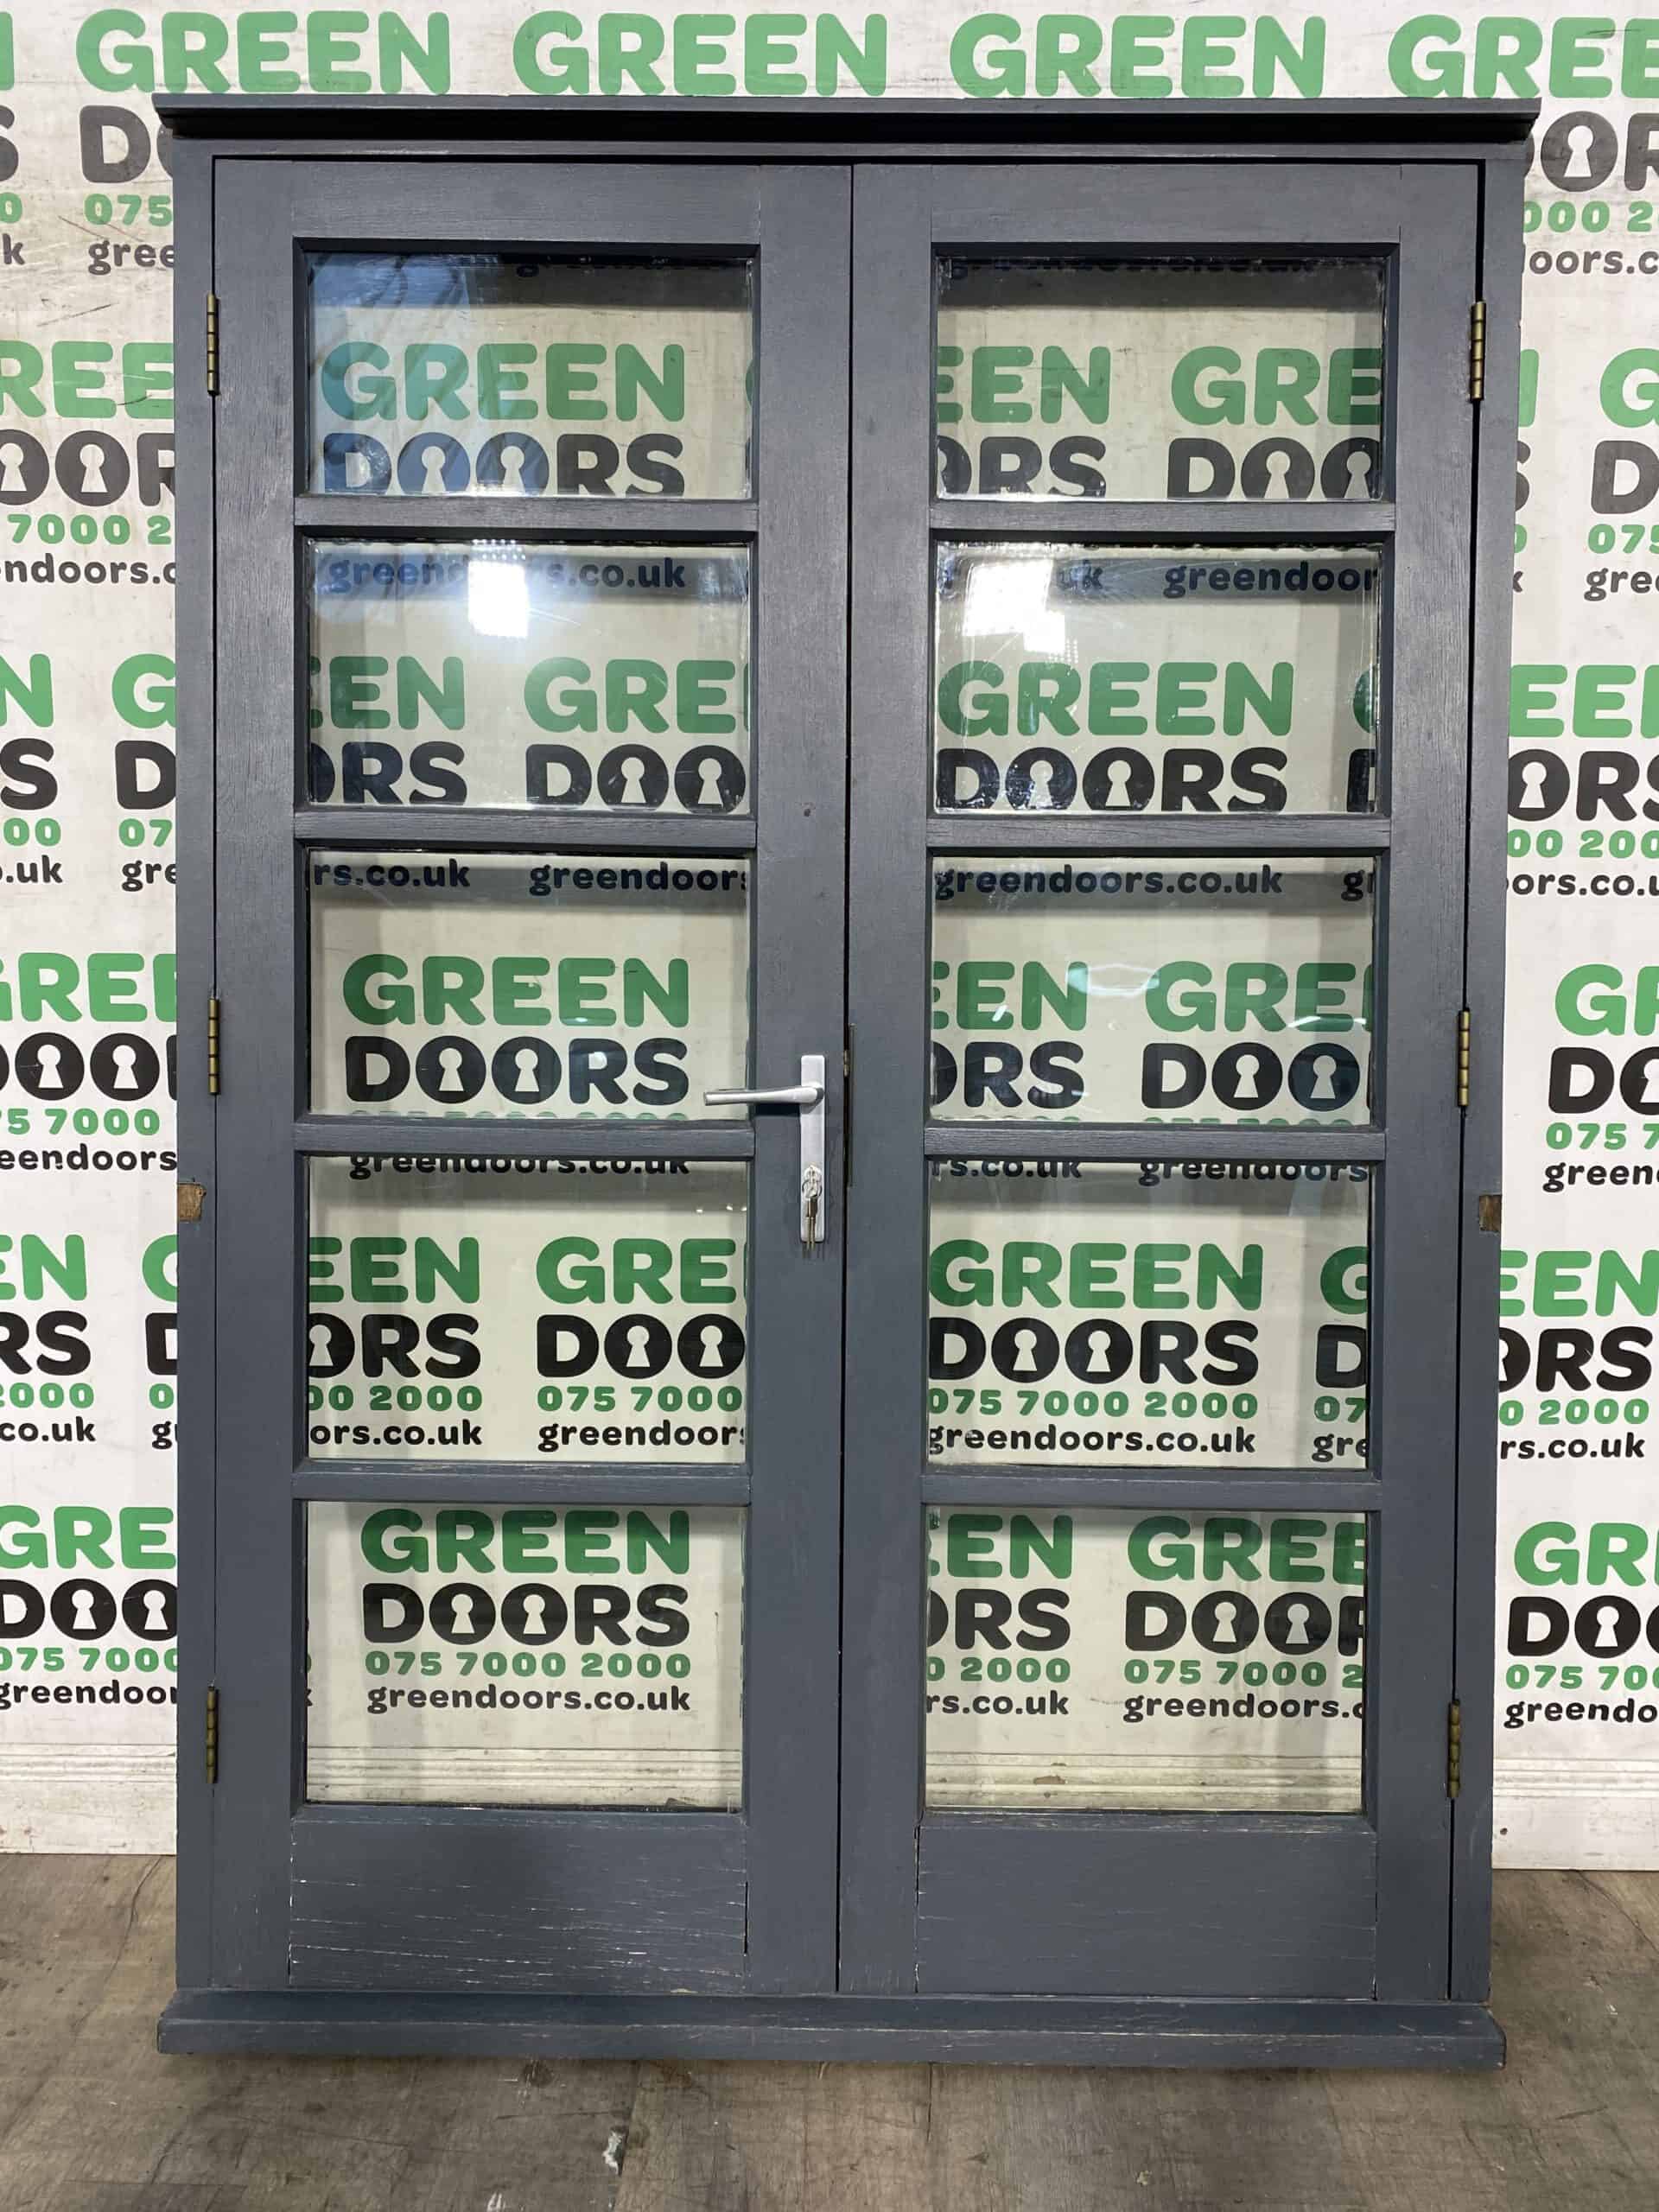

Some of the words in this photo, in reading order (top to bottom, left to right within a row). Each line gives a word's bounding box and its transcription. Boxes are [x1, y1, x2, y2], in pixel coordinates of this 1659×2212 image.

[76, 10, 450, 95] GREEN
[514, 11, 887, 97] GREEN
[950, 14, 1325, 99] GREEN
[84, 194, 173, 226] 075
[322, 341, 684, 423] GREEN
[323, 433, 685, 497] DOORS
[8, 514, 130, 544] 7000
[0, 553, 175, 584] ndoors.c
[1584, 568, 1659, 601] gre
[311, 656, 465, 729] EN
[524, 658, 749, 734] GRE
[938, 663, 1294, 737] GREEN
[936, 747, 1287, 810] DOORS
[934, 865, 1282, 899] greendoors.co.uk
[344, 954, 689, 1027] GREEN
[933, 962, 1087, 1031] EN
[1146, 961, 1371, 1032] GRE
[345, 1036, 689, 1105] DOORS
[1141, 1042, 1370, 1111] DOO
[45, 1108, 160, 1135] 7000
[1546, 1122, 1625, 1150] 075
[1543, 1162, 1659, 1192] green
[537, 1236, 747, 1304] GRE
[930, 1240, 1263, 1309] GREEN
[537, 1314, 746, 1379] DOO
[930, 1317, 1258, 1386] DOORS
[0, 1382, 94, 1408] 000
[372, 1385, 482, 1410] 2000
[537, 1385, 615, 1411] 075
[631, 1385, 741, 1411] 7000
[930, 1388, 1001, 1414] 075
[1018, 1391, 1128, 1416] 7000
[1145, 1391, 1257, 1419] 2000
[1539, 1398, 1649, 1424] 2000
[931, 1424, 1255, 1454] greendoors.co.uk
[362, 1510, 690, 1574] GREEN
[363, 1583, 690, 1647] DOORS
[365, 1651, 441, 1678] 075
[456, 1652, 566, 1677] 7000
[581, 1652, 691, 1678] 2000
[961, 1657, 1071, 1682] 2000
[1124, 1659, 1200, 1685] 075
[1217, 1660, 1327, 1687] 7000
[1506, 1664, 1583, 1690] 075
[367, 1684, 690, 1714] greendoors.co.uk
